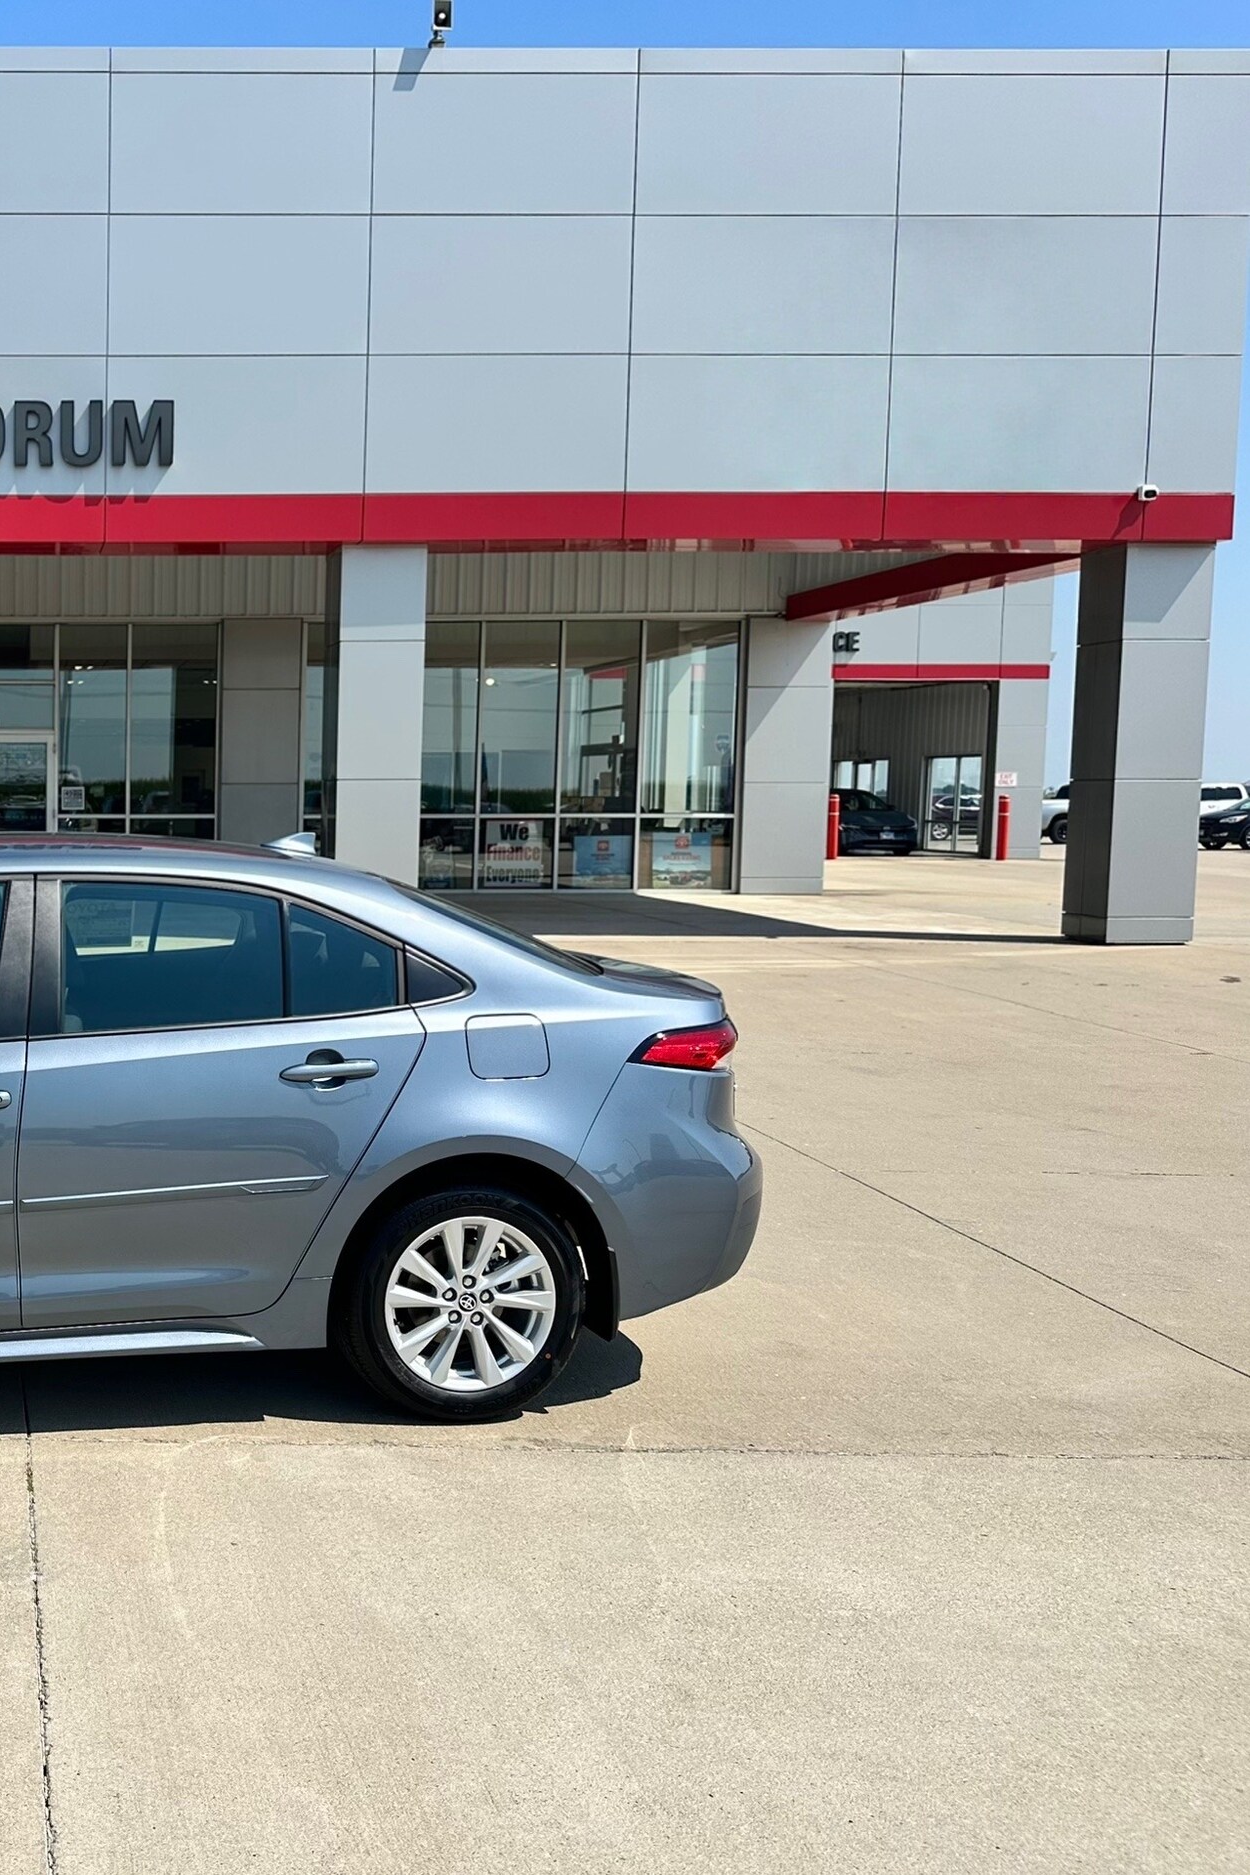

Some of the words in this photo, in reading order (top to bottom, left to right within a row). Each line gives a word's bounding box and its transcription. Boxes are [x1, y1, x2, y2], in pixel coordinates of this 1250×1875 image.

[500, 823, 529, 841] We
[486, 843, 540, 861] Finance
[486, 866, 540, 884] Everyone
